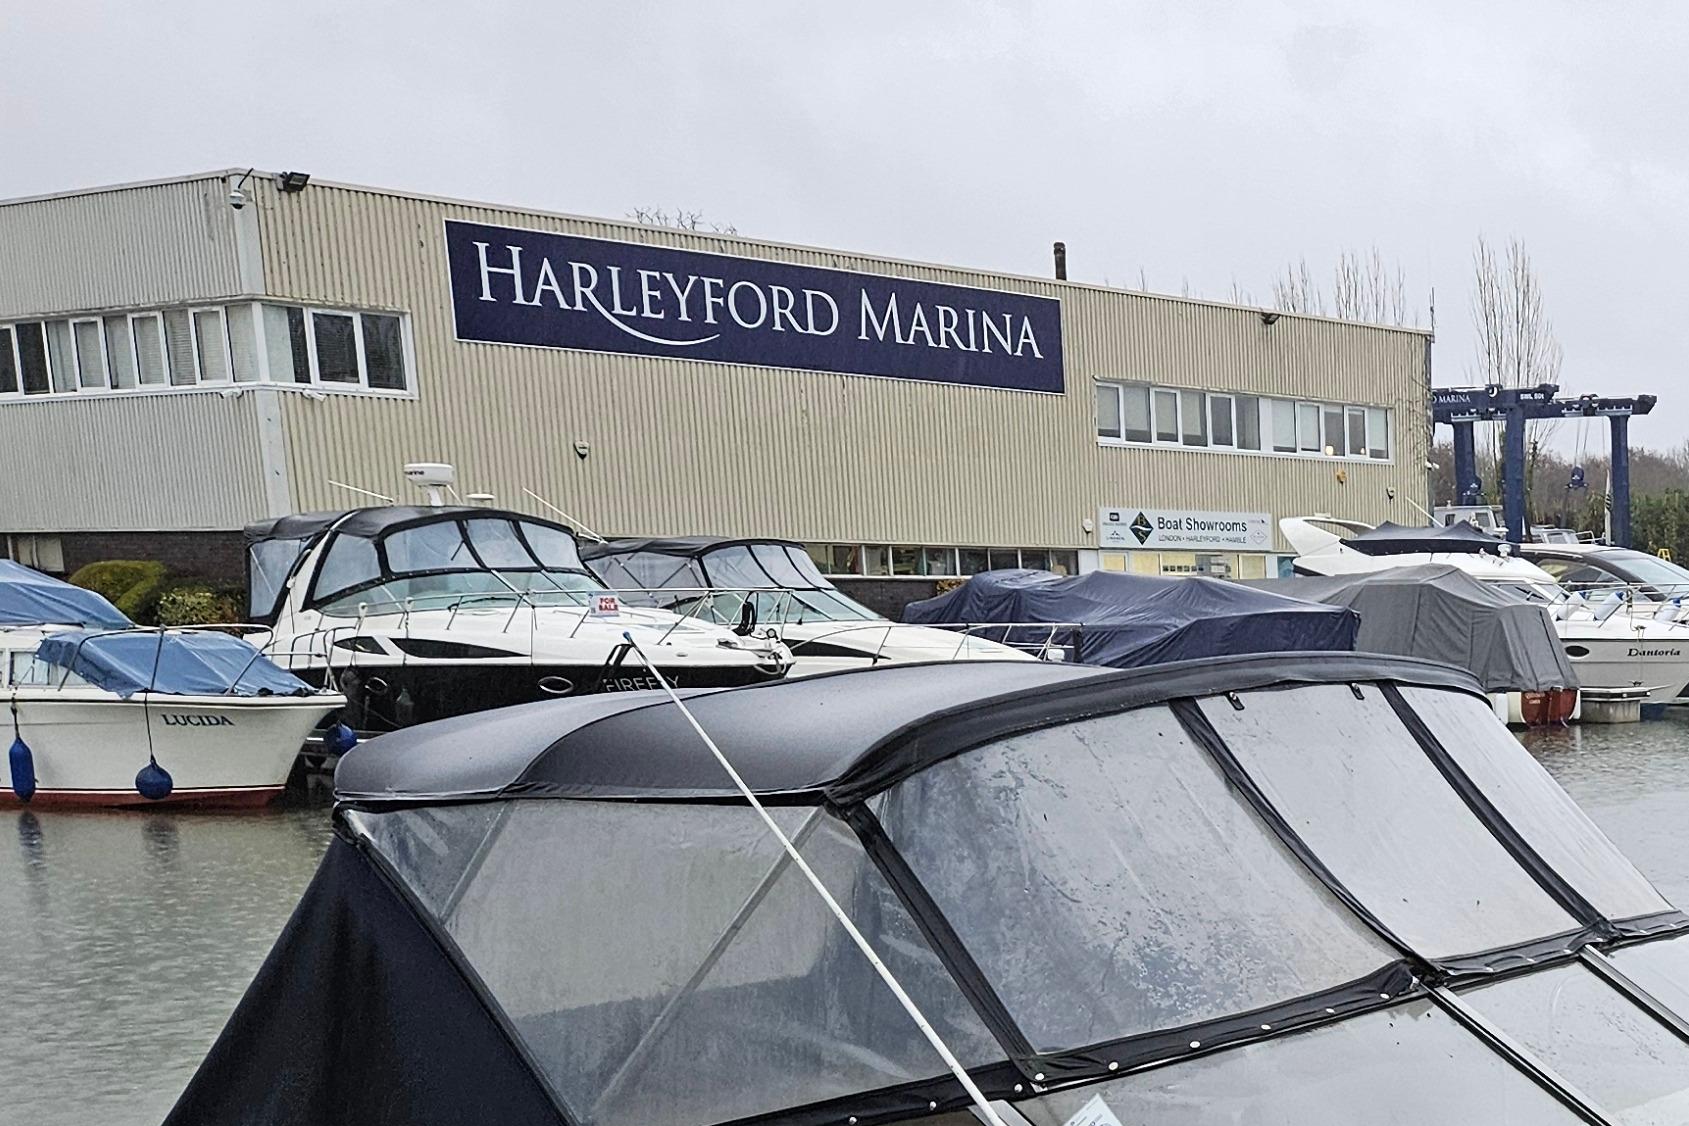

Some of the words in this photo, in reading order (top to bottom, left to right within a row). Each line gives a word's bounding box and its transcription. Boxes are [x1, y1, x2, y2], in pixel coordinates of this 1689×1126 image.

[472, 241, 839, 346] HARLEYFORD
[857, 289, 1044, 359] MARINA
[1157, 516, 1183, 530] Boat
[1185, 517, 1247, 532] Showrooms
[161, 713, 235, 727] LUCIDA
